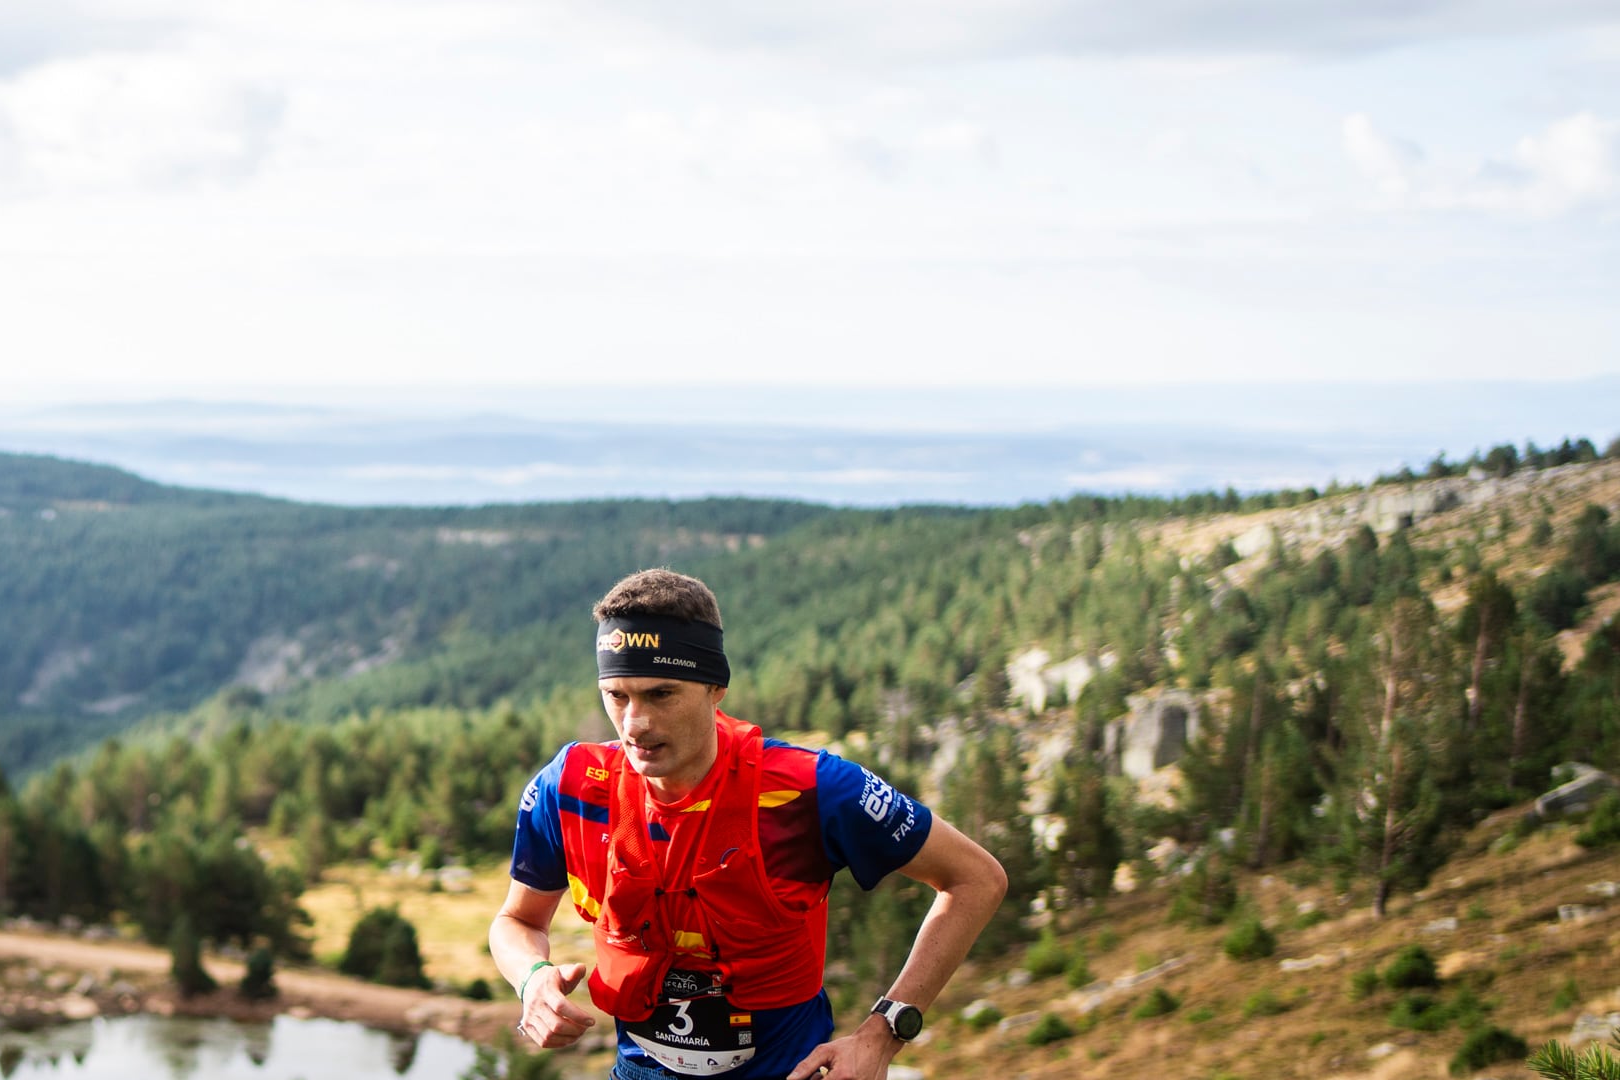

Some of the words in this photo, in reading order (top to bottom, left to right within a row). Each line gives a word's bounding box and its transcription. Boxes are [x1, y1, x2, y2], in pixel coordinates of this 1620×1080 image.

[652, 657, 696, 668] SALOMON
[585, 766, 610, 782] ESP
[668, 998, 694, 1036] 3
[655, 1031, 710, 1046] SANTAMARÍA
